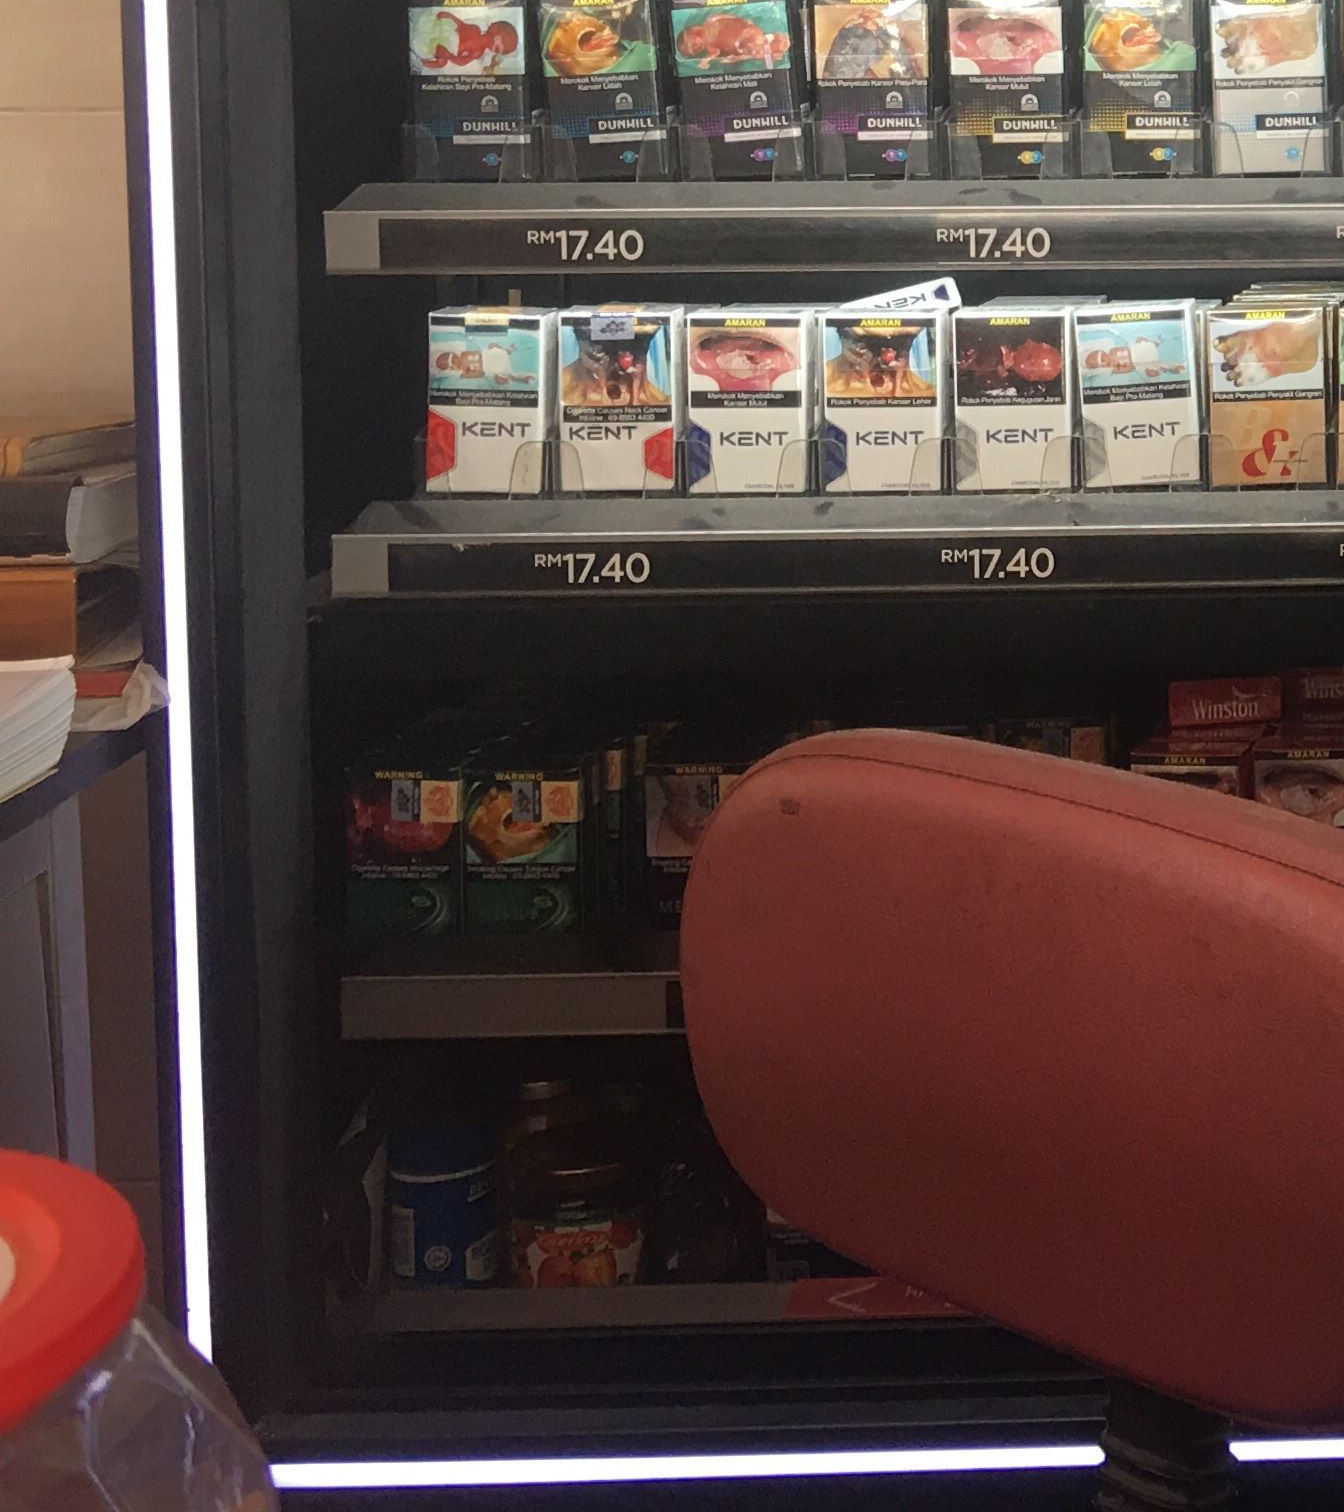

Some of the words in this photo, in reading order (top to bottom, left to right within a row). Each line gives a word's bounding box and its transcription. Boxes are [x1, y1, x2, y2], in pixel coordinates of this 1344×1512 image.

[463, 121, 519, 132] DUNHILL
[598, 118, 654, 130] DUNHILL
[733, 116, 788, 129] DUNHILL
[868, 117, 922, 128] DUNHILL
[1003, 120, 1057, 130] DUNHILL
[1136, 116, 1189, 127] DUNHILL
[1266, 117, 1316, 127] DUNHILL
[526, 228, 645, 262] RM17.40
[935, 227, 1051, 260] RM17.40
[874, 293, 926, 309] KEN
[725, 319, 765, 327] AMARAN
[861, 319, 901, 327] AMARAN
[1111, 313, 1150, 322] AMARAN
[462, 422, 531, 437] KENT
[570, 427, 637, 440] KENT
[1113, 422, 1180, 440] KENT
[720, 432, 789, 446] KENT
[856, 431, 924, 446] KENT
[987, 429, 1054, 443] KENT
[533, 552, 651, 585] RM17.40
[940, 547, 1055, 580] RM17.40
[1192, 700, 1258, 722] Winston
[1287, 749, 1329, 758] AMARAN
[1164, 757, 1206, 765] AMARAN
[375, 771, 423, 779] WARNING
[675, 766, 723, 774] WARNING
[495, 773, 544, 781] WARNING
